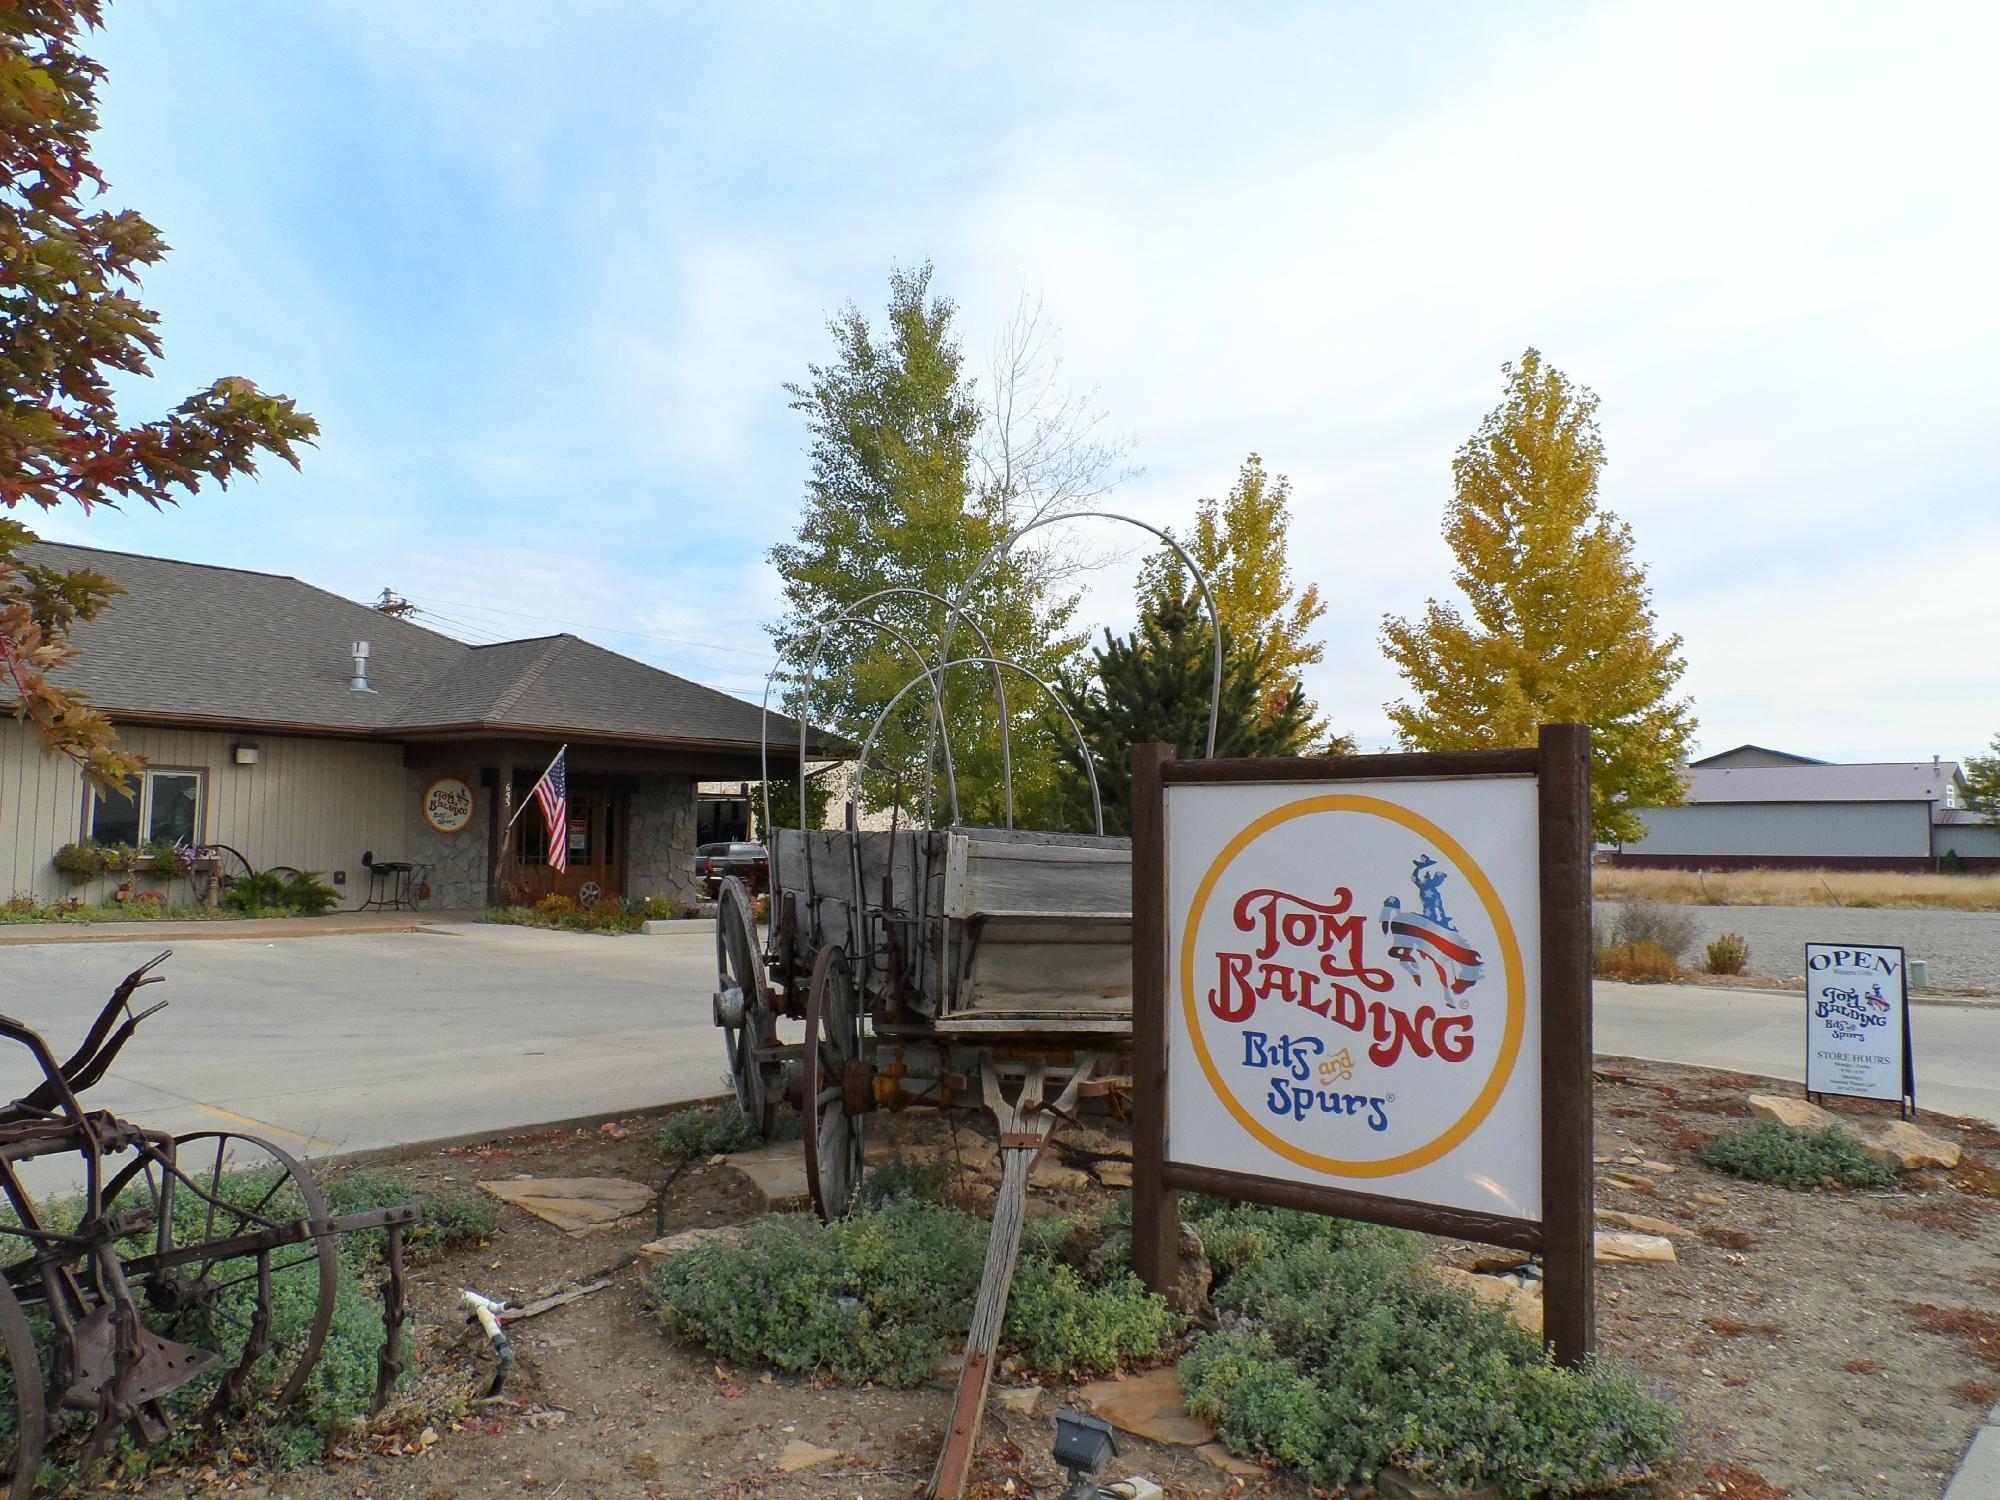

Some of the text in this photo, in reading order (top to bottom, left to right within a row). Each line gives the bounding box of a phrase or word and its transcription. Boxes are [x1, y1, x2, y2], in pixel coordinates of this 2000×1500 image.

[1233, 886, 1395, 993] TOM
[1809, 950, 1901, 976] OPEN
[1208, 951, 1474, 1068] BALDING
[1822, 987, 1867, 1012] TOM
[1815, 1001, 1887, 1028] BALDING
[1825, 1019, 1848, 1031] Bits
[1832, 1030, 1865, 1042] Spurs
[1241, 1030, 1355, 1086] Bits and
[1816, 1050, 1851, 1061] STORE
[1852, 1054, 1891, 1065] HOURS
[1267, 1077, 1389, 1132] Spurs
